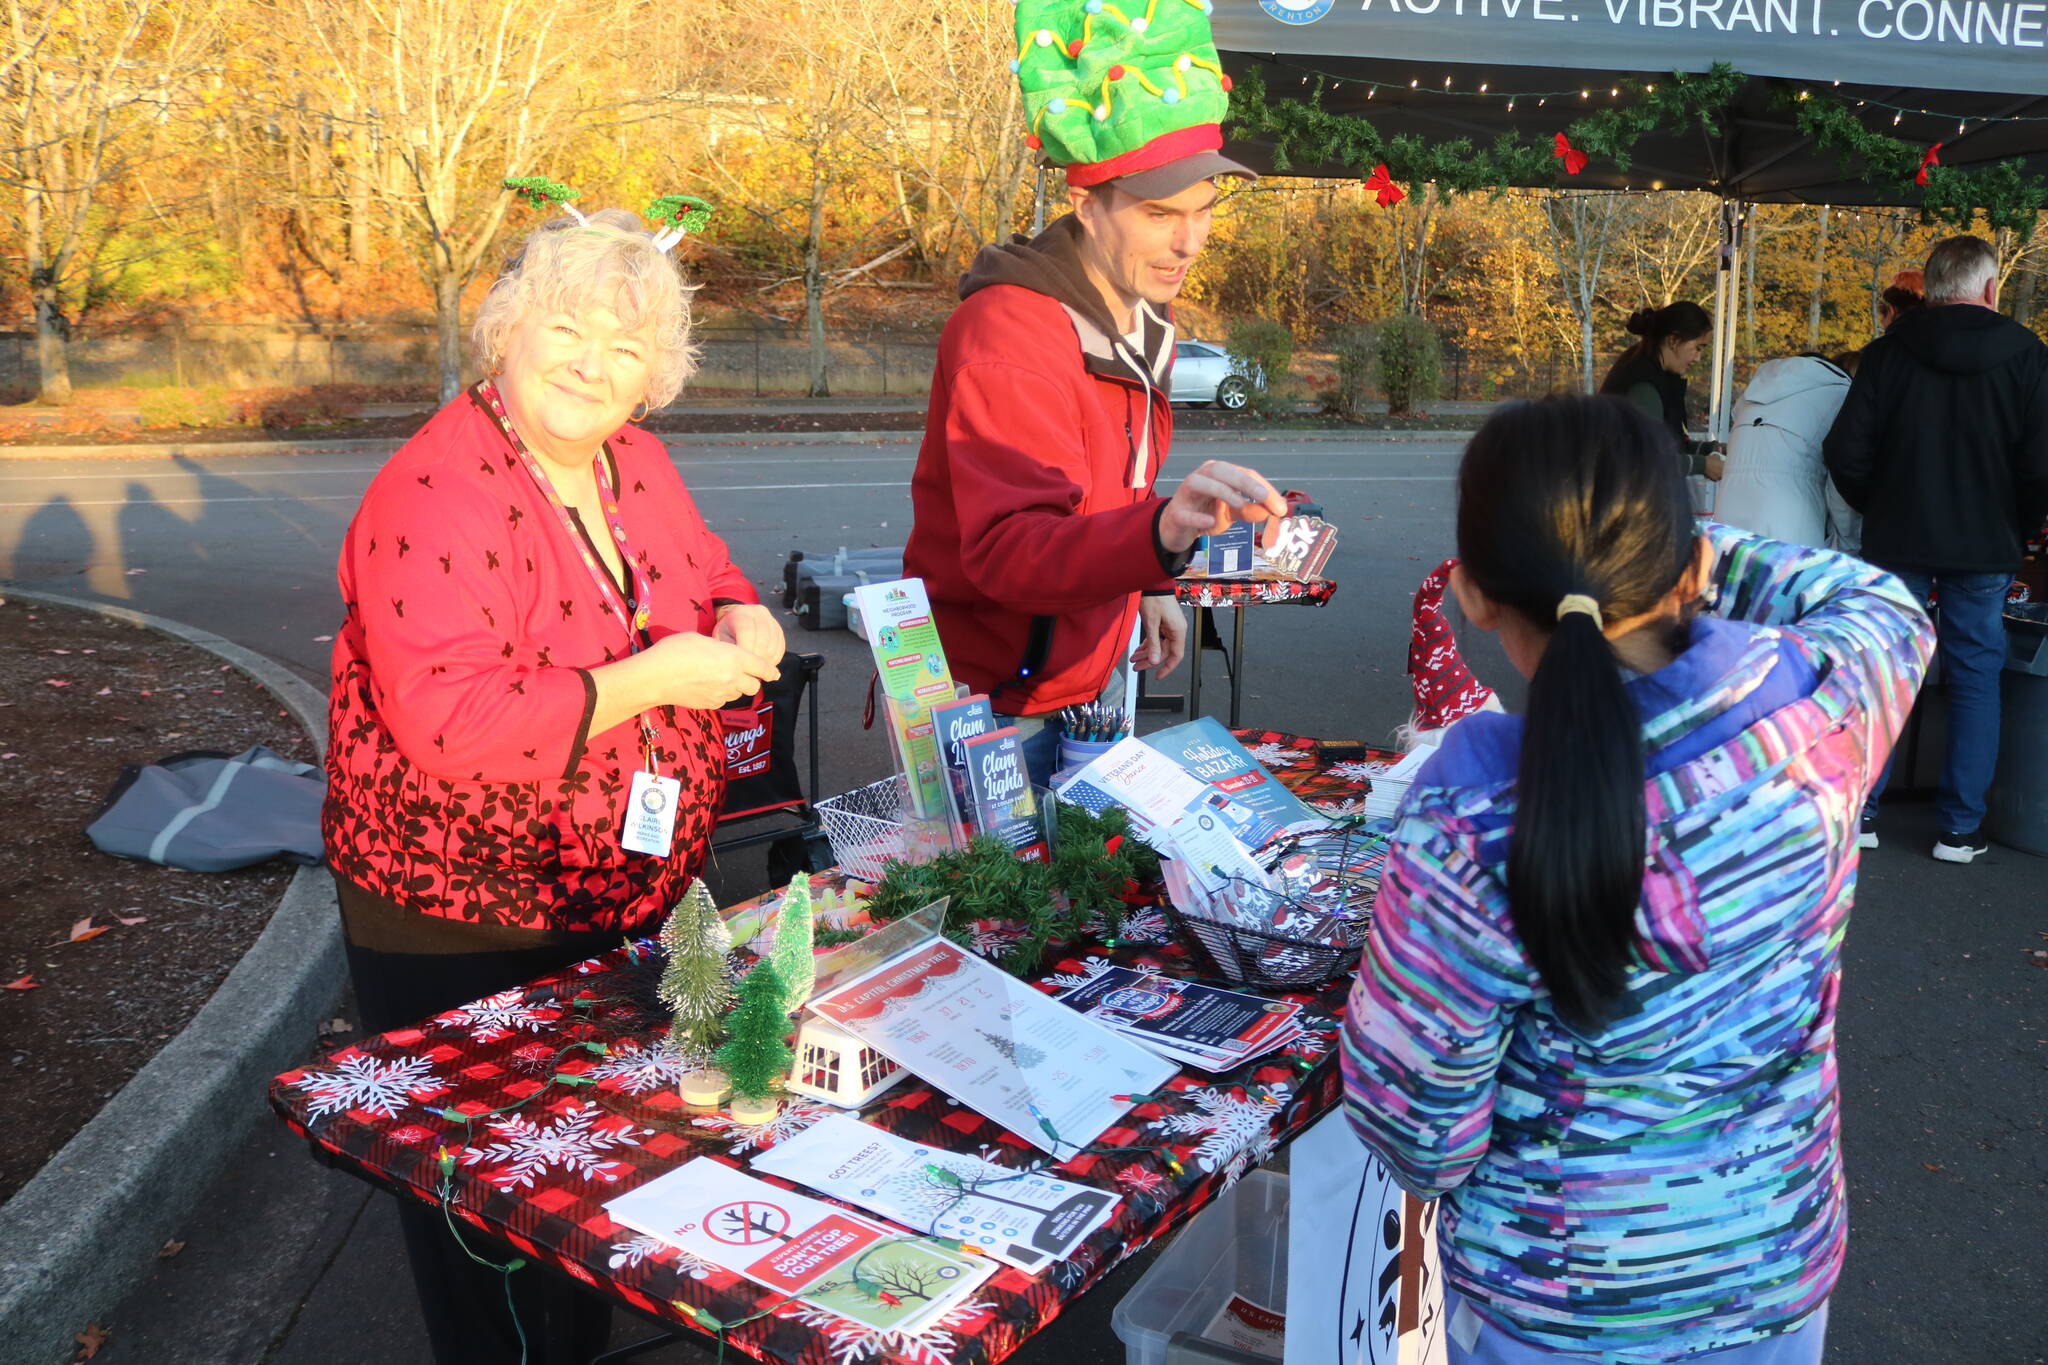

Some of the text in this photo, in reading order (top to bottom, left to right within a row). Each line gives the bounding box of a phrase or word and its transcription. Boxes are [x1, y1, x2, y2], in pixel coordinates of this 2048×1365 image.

[1268, 4, 1324, 21] RENTON
[1288, 518, 1318, 559] 5K
[724, 723, 766, 752] lings
[950, 717, 985, 742] Clam
[983, 751, 1018, 777] Clam
[1182, 744, 1233, 763] Holiday
[1100, 750, 1146, 784] VETERANS DAY
[1117, 764, 1146, 786] Dance
[1194, 755, 1248, 778] BAZAAR
[984, 768, 1024, 801] Lights
[1294, 912, 1323, 932] 5K
[856, 984, 890, 1005] CAPITOL
[886, 962, 932, 987] CHRISTMAS
[930, 951, 950, 965] TREE
[1108, 989, 1140, 1006] Battle
[828, 1162, 852, 1180] GOT
[848, 1142, 881, 1165] TREES?
[673, 1222, 697, 1236] NO
[769, 1245, 801, 1263] EXPERTS
[773, 1228, 842, 1272] DON'T TOP
[783, 1231, 860, 1279] YOUR TREE!
[1258, 1314, 1284, 1327] CAPIT
